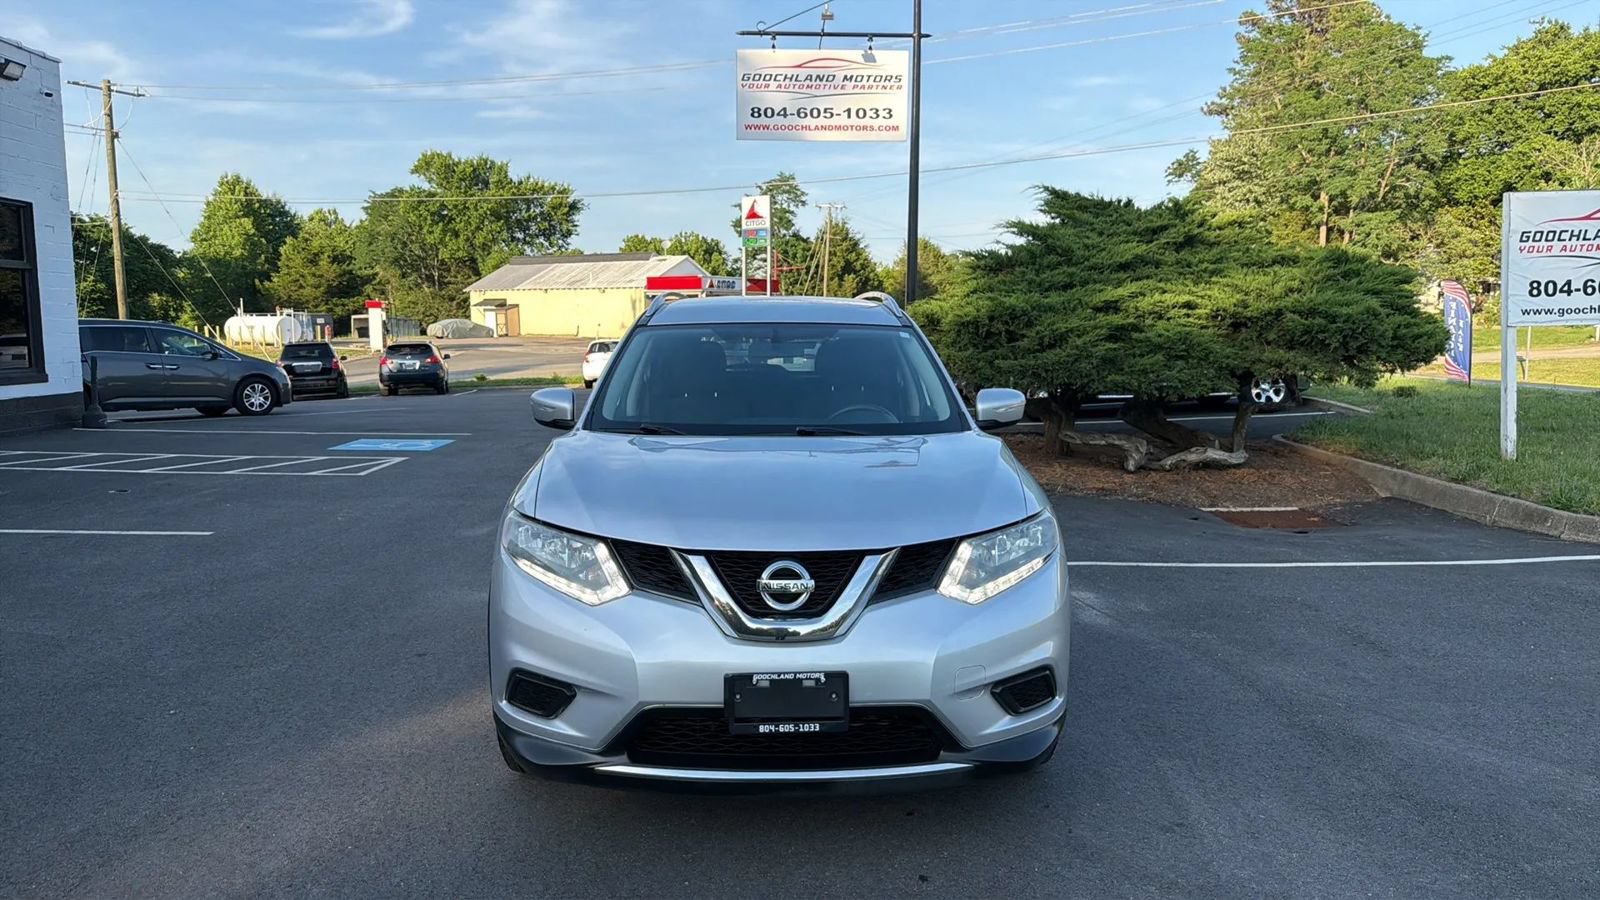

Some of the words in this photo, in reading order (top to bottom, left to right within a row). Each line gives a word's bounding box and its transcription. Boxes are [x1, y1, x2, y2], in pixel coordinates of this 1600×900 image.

[741, 73, 836, 83] GOOCHLAND
[842, 74, 903, 83] MOTORS
[750, 106, 894, 120] 804-605-1033
[744, 123, 900, 132] WWW.GOOCHLANDMOTORS.COM
[1519, 244, 1554, 254] YOUR
[1528, 278, 1600, 298] 804-6
[761, 582, 809, 590] NISSAN
[759, 723, 820, 733] 804-605-1033
